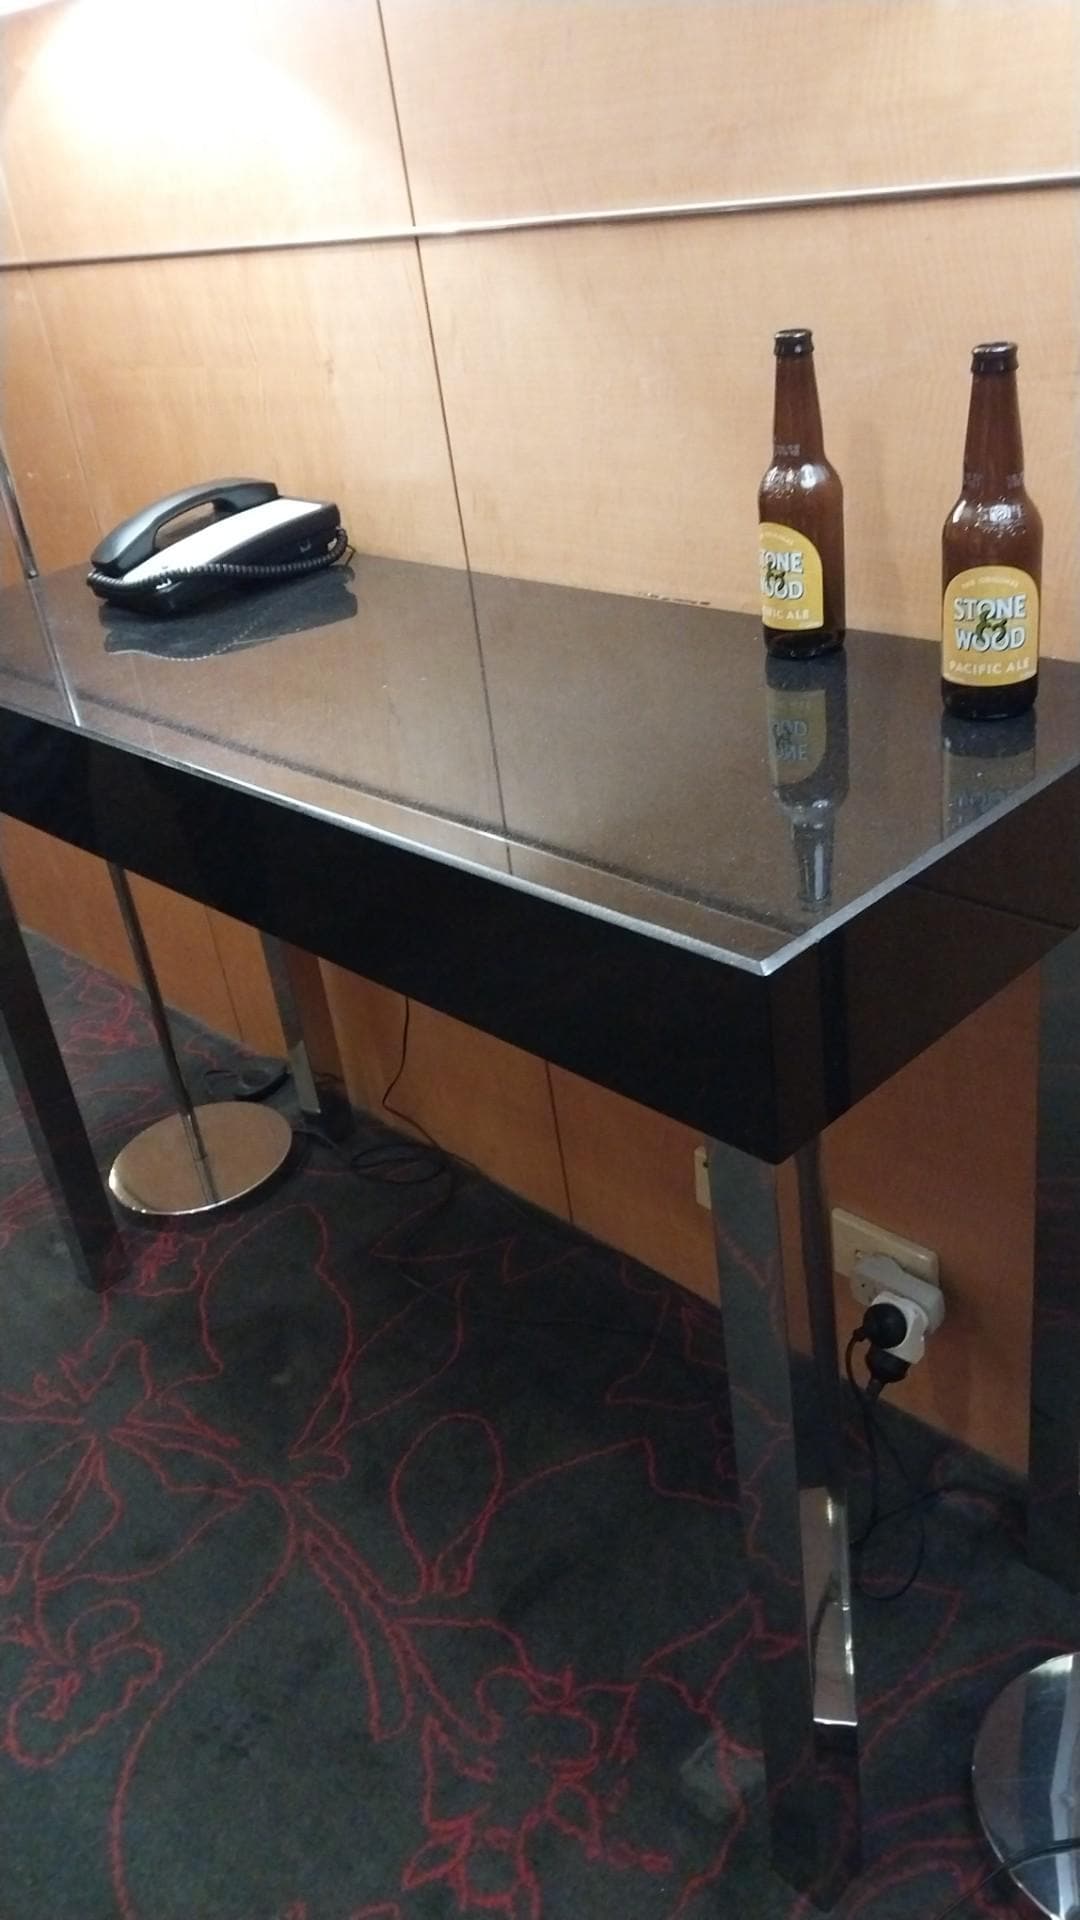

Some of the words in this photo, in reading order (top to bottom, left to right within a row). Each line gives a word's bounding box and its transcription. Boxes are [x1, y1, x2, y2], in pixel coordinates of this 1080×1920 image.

[954, 593, 1027, 621] STONE
[955, 627, 1026, 652] WOOD
[949, 659, 1002, 675] PACIFIC
[1006, 656, 1031, 673] ALE
